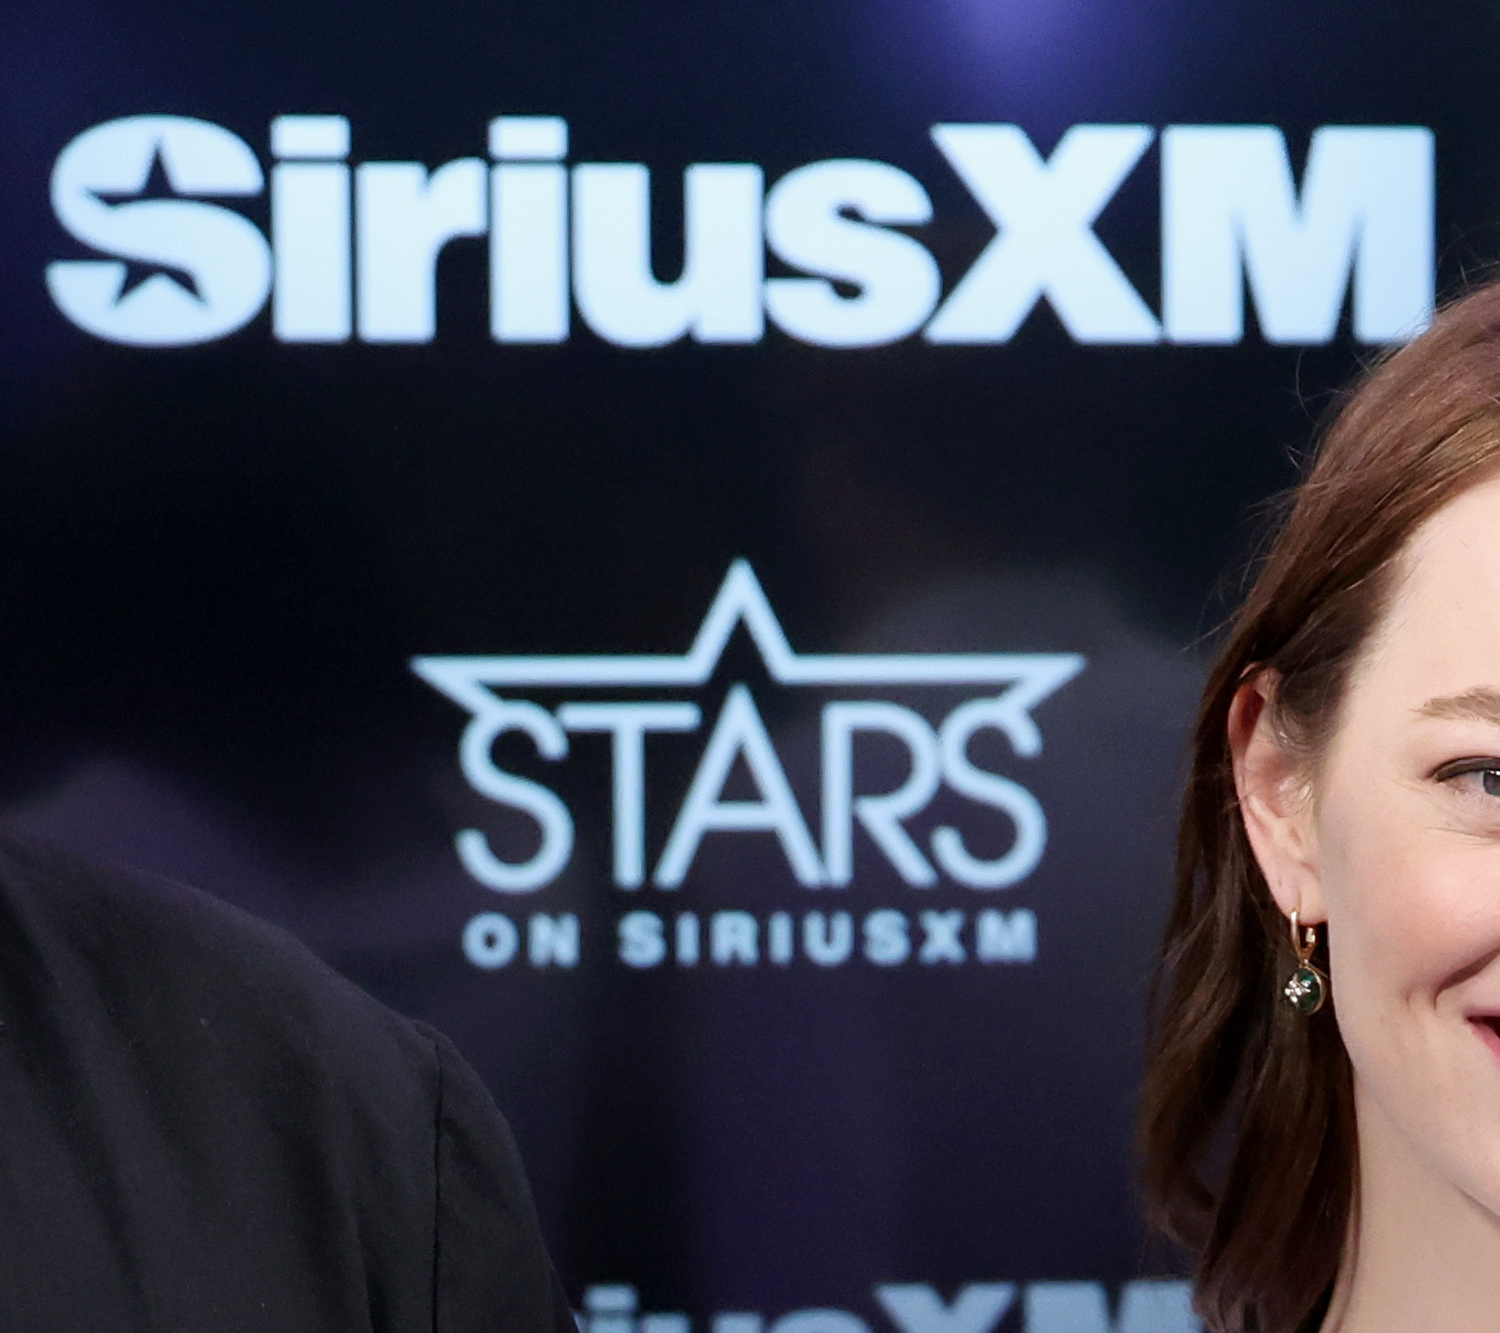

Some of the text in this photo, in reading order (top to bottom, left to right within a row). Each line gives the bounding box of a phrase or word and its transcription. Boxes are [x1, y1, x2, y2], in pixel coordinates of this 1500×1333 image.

[46, 114, 1436, 348] SiriusXM
[454, 686, 1052, 893] STARS
[463, 909, 1038, 969] ON SIRIUSXM
